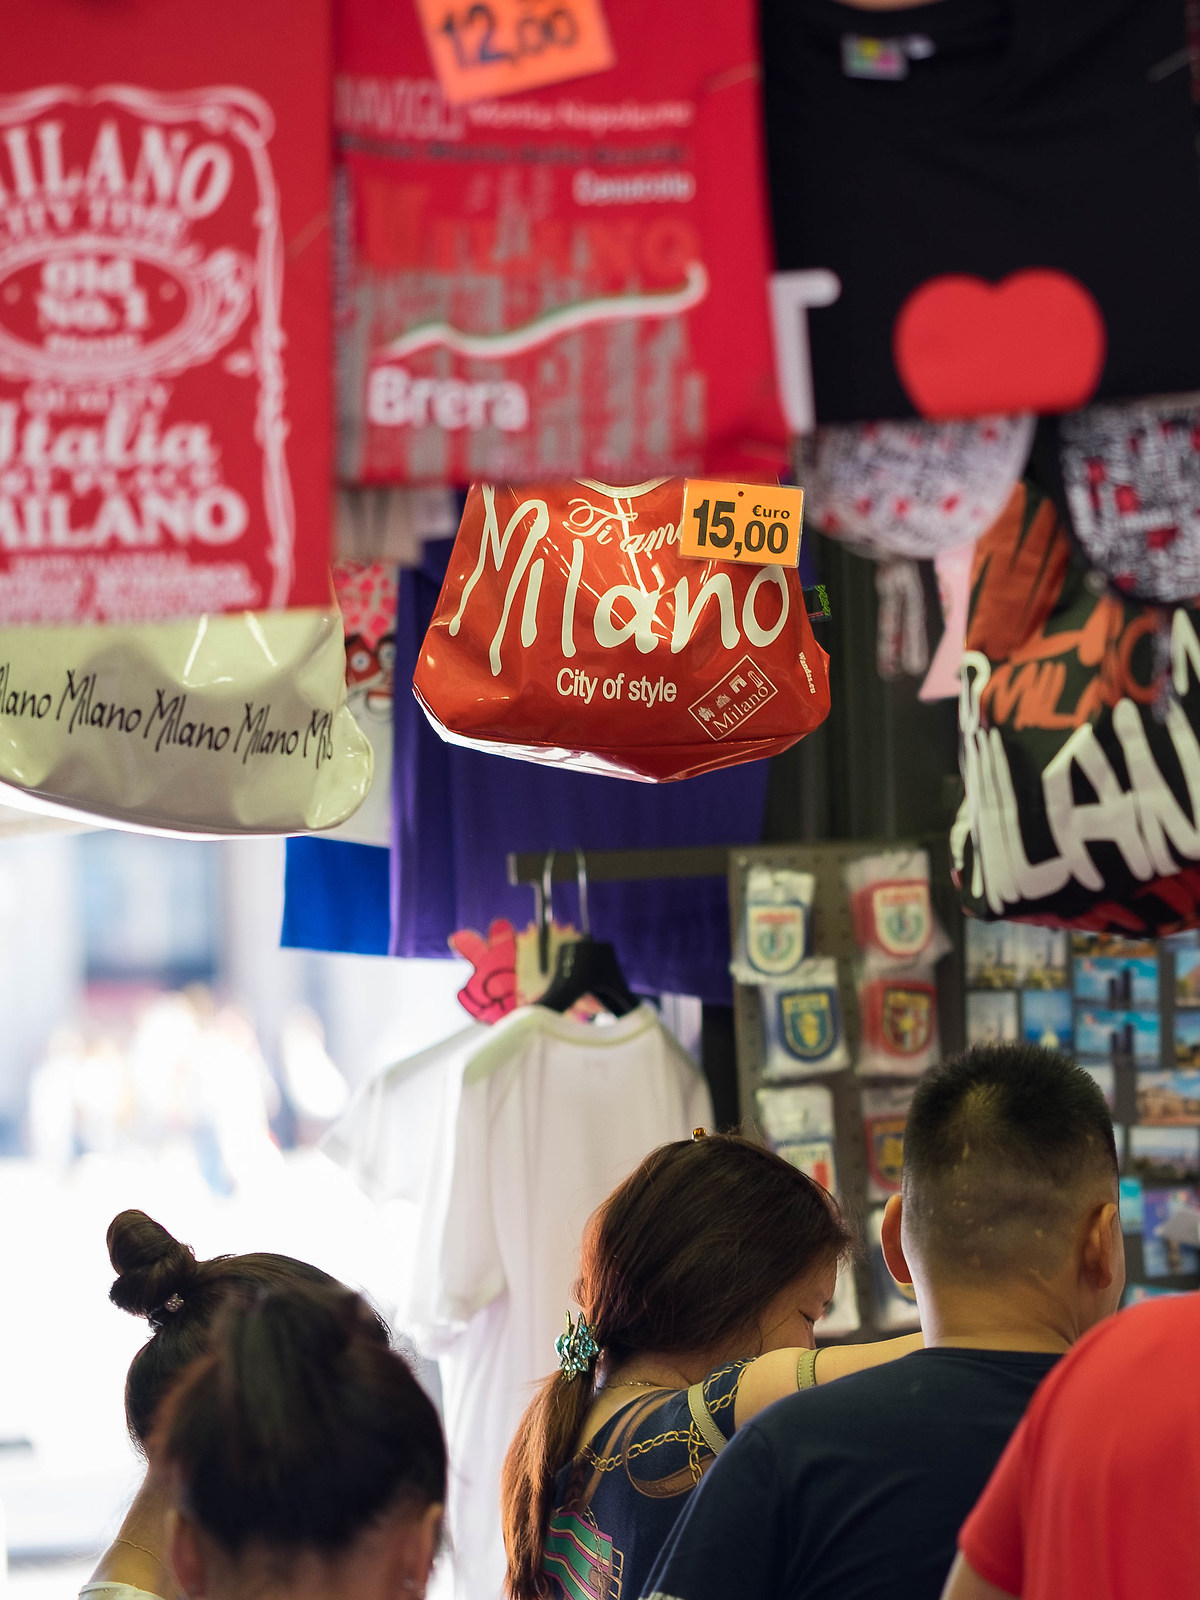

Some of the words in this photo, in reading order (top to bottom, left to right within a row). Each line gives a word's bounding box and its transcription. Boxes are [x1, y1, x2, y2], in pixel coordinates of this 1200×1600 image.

[0, 117, 234, 222] ILANO
[367, 366, 529, 431] Brera
[619, 522, 682, 554] am
[693, 499, 789, 558] 15,00
[752, 504, 790, 519] €uro
[449, 484, 790, 676] Milano
[0, 662, 52, 719] lano
[56, 669, 142, 734] Milano
[143, 688, 230, 753] Milano
[233, 702, 299, 765] Milano
[556, 667, 599, 704] City
[602, 673, 625, 700] of
[628, 676, 677, 708] style
[712, 685, 769, 734] Milano
